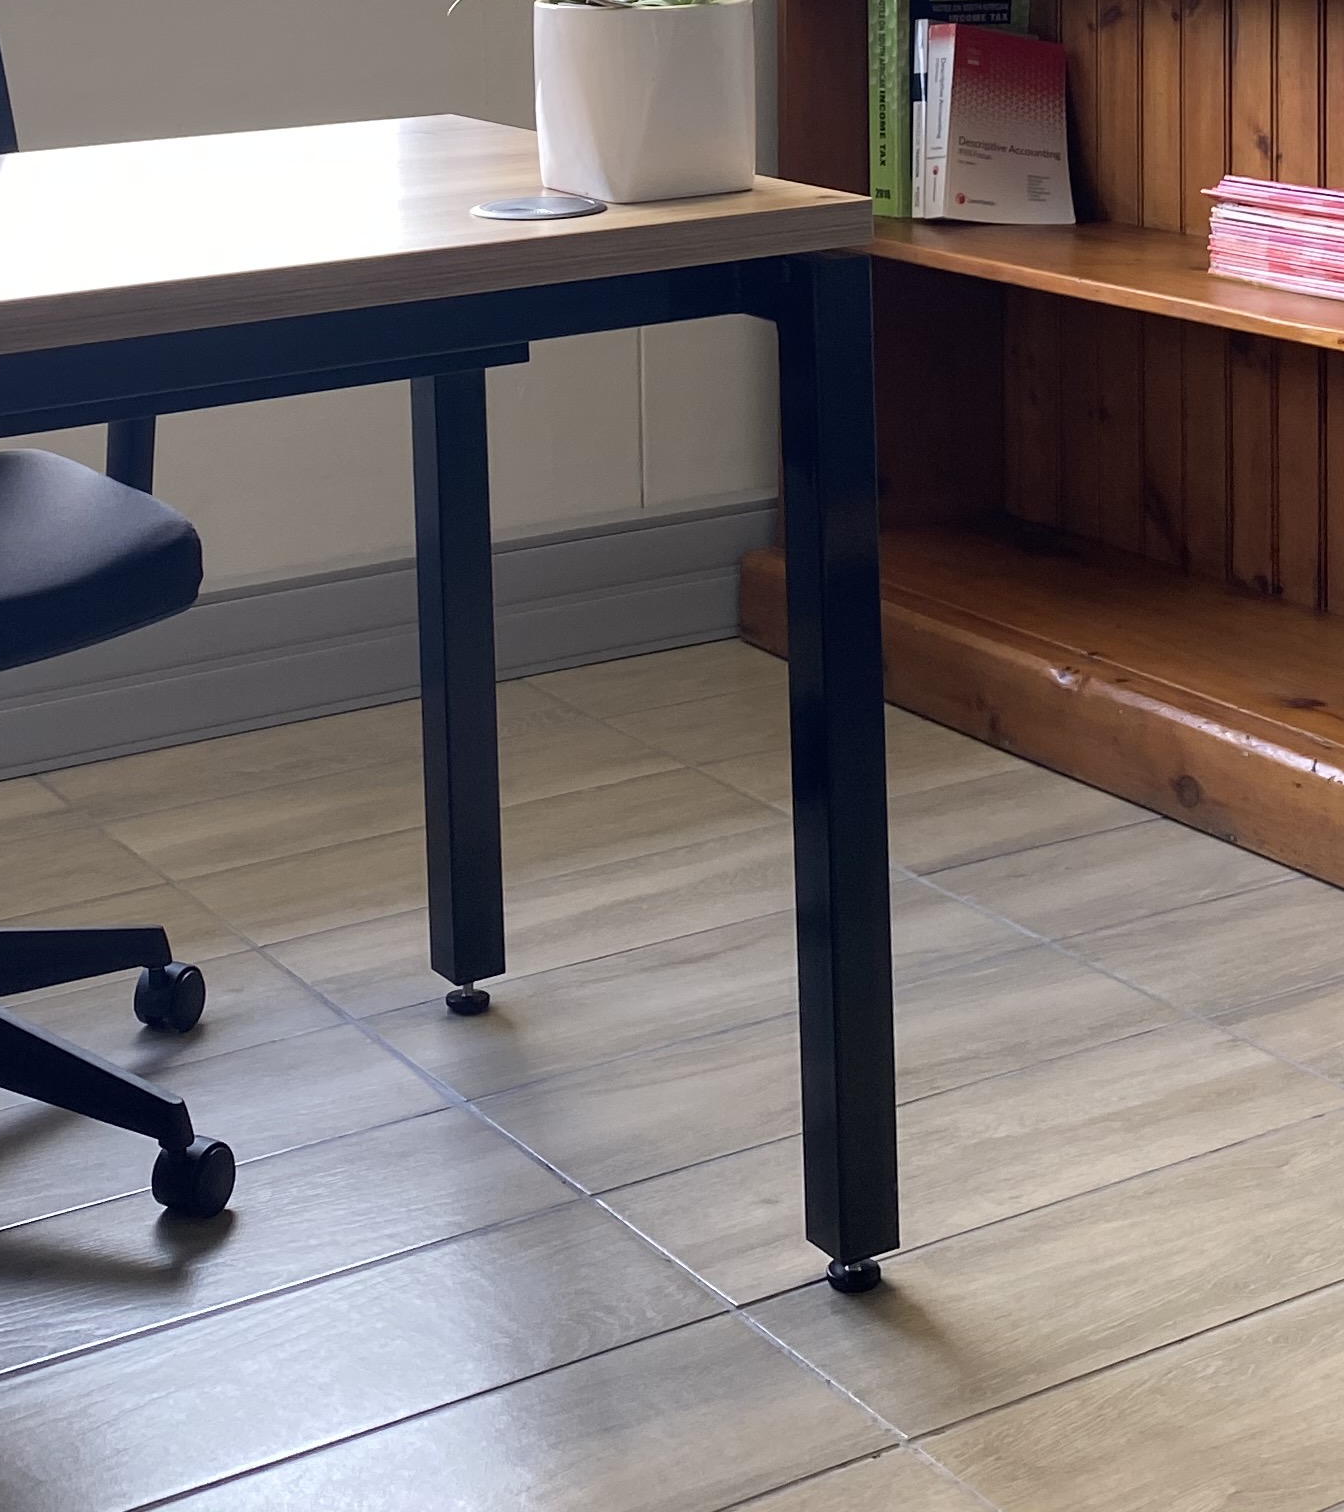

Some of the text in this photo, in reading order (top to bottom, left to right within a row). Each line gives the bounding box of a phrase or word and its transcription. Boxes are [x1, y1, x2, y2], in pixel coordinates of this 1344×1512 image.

[949, 12, 1009, 22] INCOME TAX
[879, 90, 887, 139] INCOME
[879, 143, 887, 167] TAX
[958, 135, 1062, 162] Descriptive Accounting
